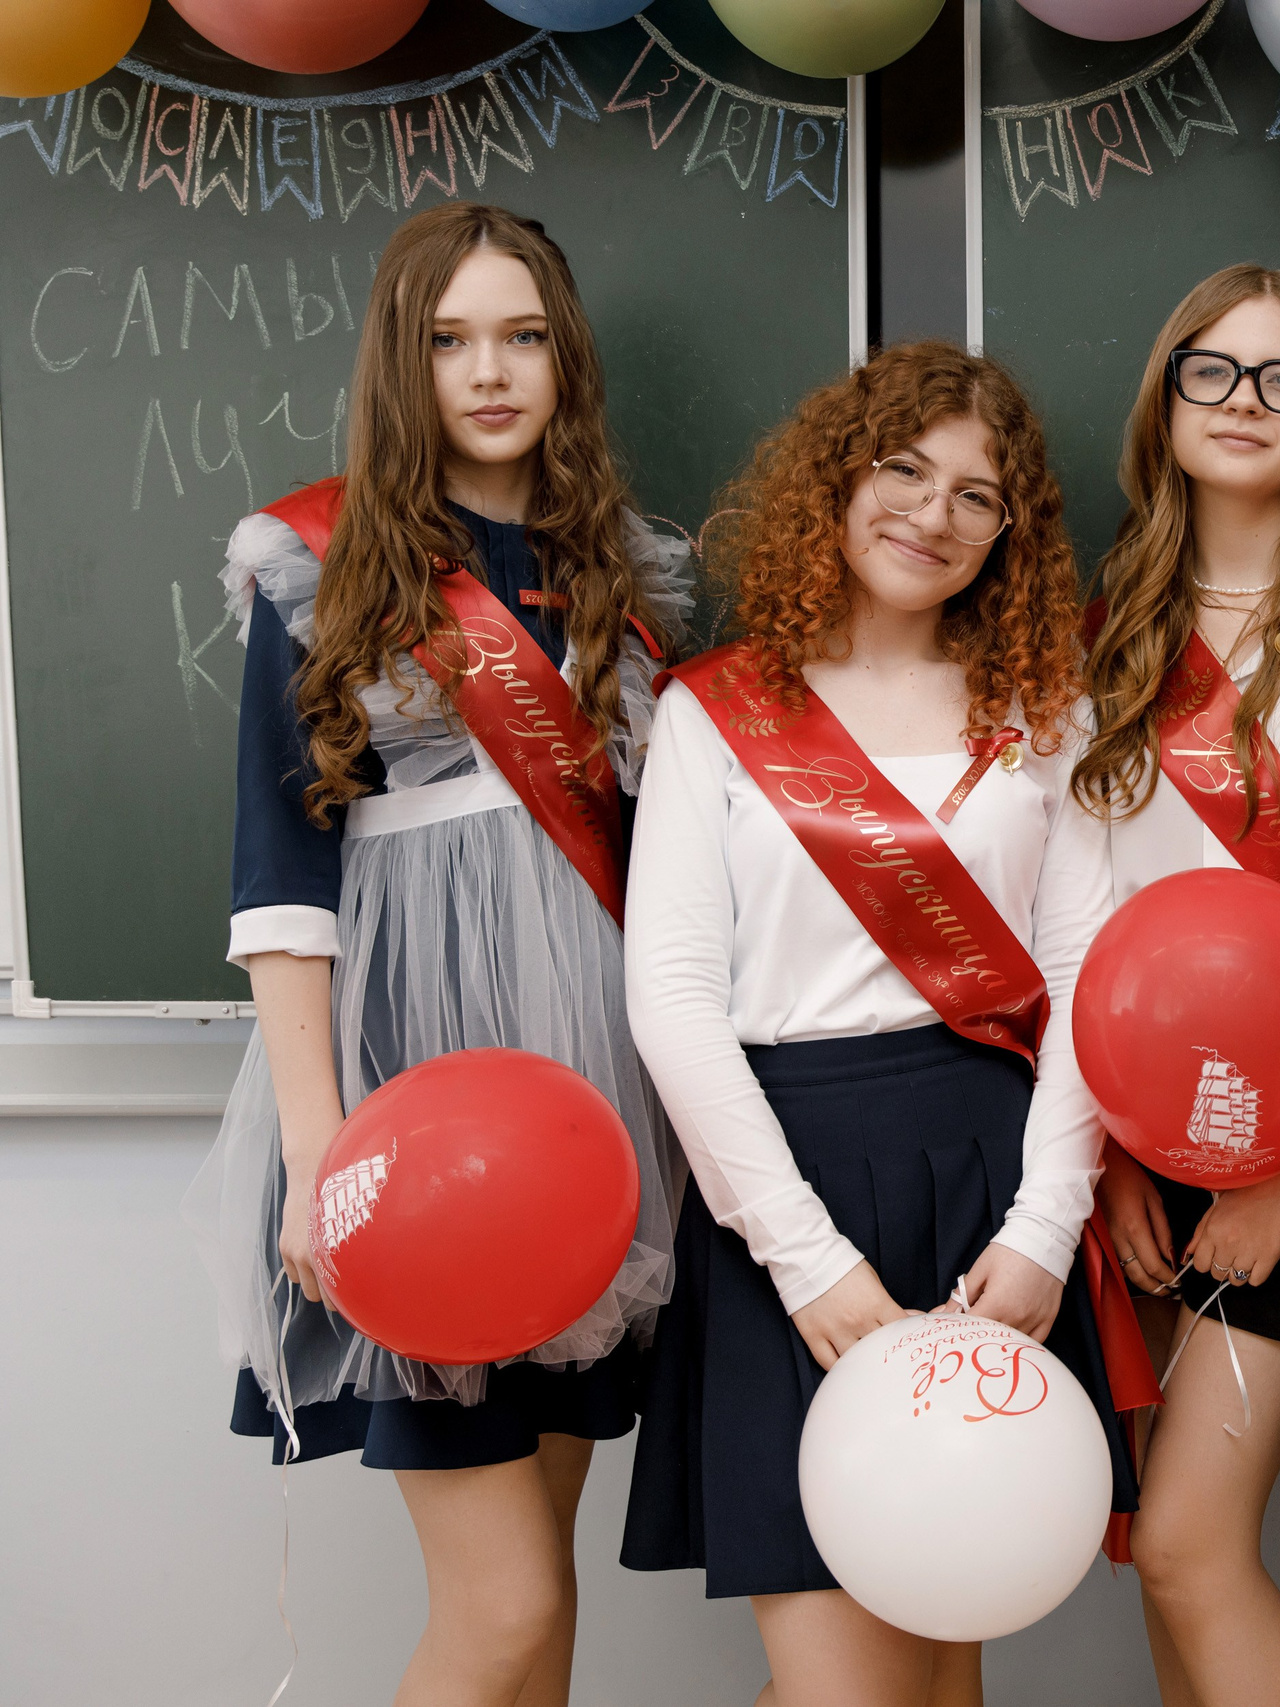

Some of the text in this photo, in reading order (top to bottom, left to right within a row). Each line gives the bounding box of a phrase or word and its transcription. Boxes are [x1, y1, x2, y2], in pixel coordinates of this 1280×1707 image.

[1016, 74, 1204, 182] НОК
[31, 250, 382, 372] САМЫ
[951, 783, 970, 807] 2025
[911, 1342, 1049, 1423] Всё
